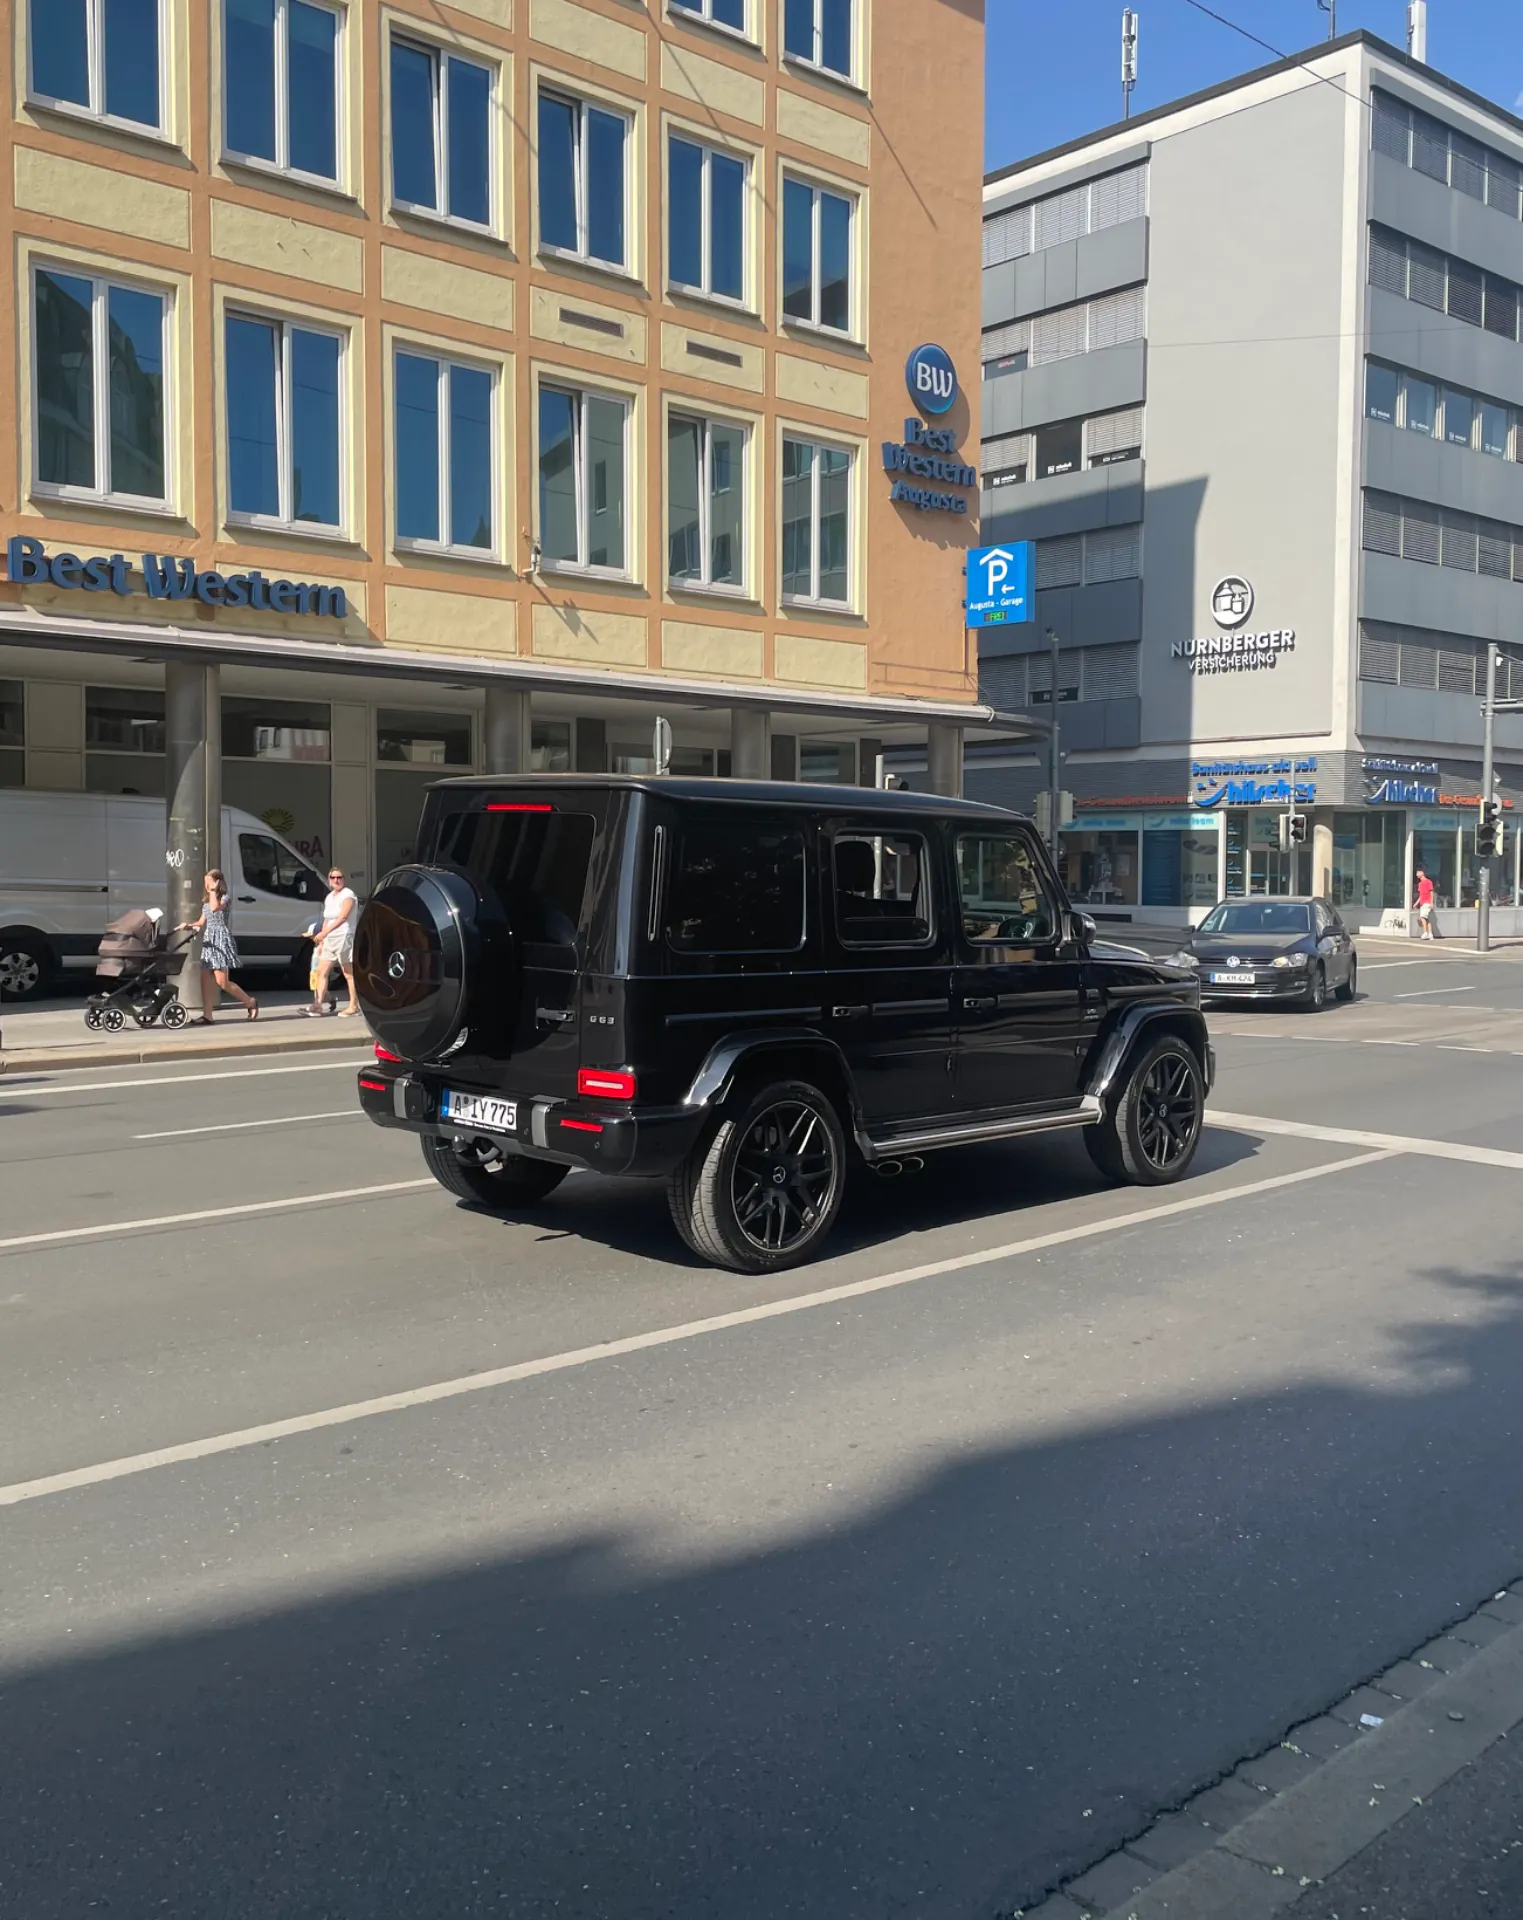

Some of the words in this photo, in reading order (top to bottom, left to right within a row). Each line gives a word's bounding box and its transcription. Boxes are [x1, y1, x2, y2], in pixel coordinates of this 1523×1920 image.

[916, 361, 953, 398] BW
[904, 417, 957, 454] Best
[882, 442, 976, 488] Western
[890, 479, 968, 514] Augusta
[7, 536, 133, 596] Best
[142, 554, 347, 618] Western
[969, 601, 995, 611] Augusta
[1000, 597, 1024, 606] Garage
[1188, 652, 1275, 671] VERSICHERUNG
[454, 1095, 462, 1115] A
[490, 1102, 515, 1125] 775
